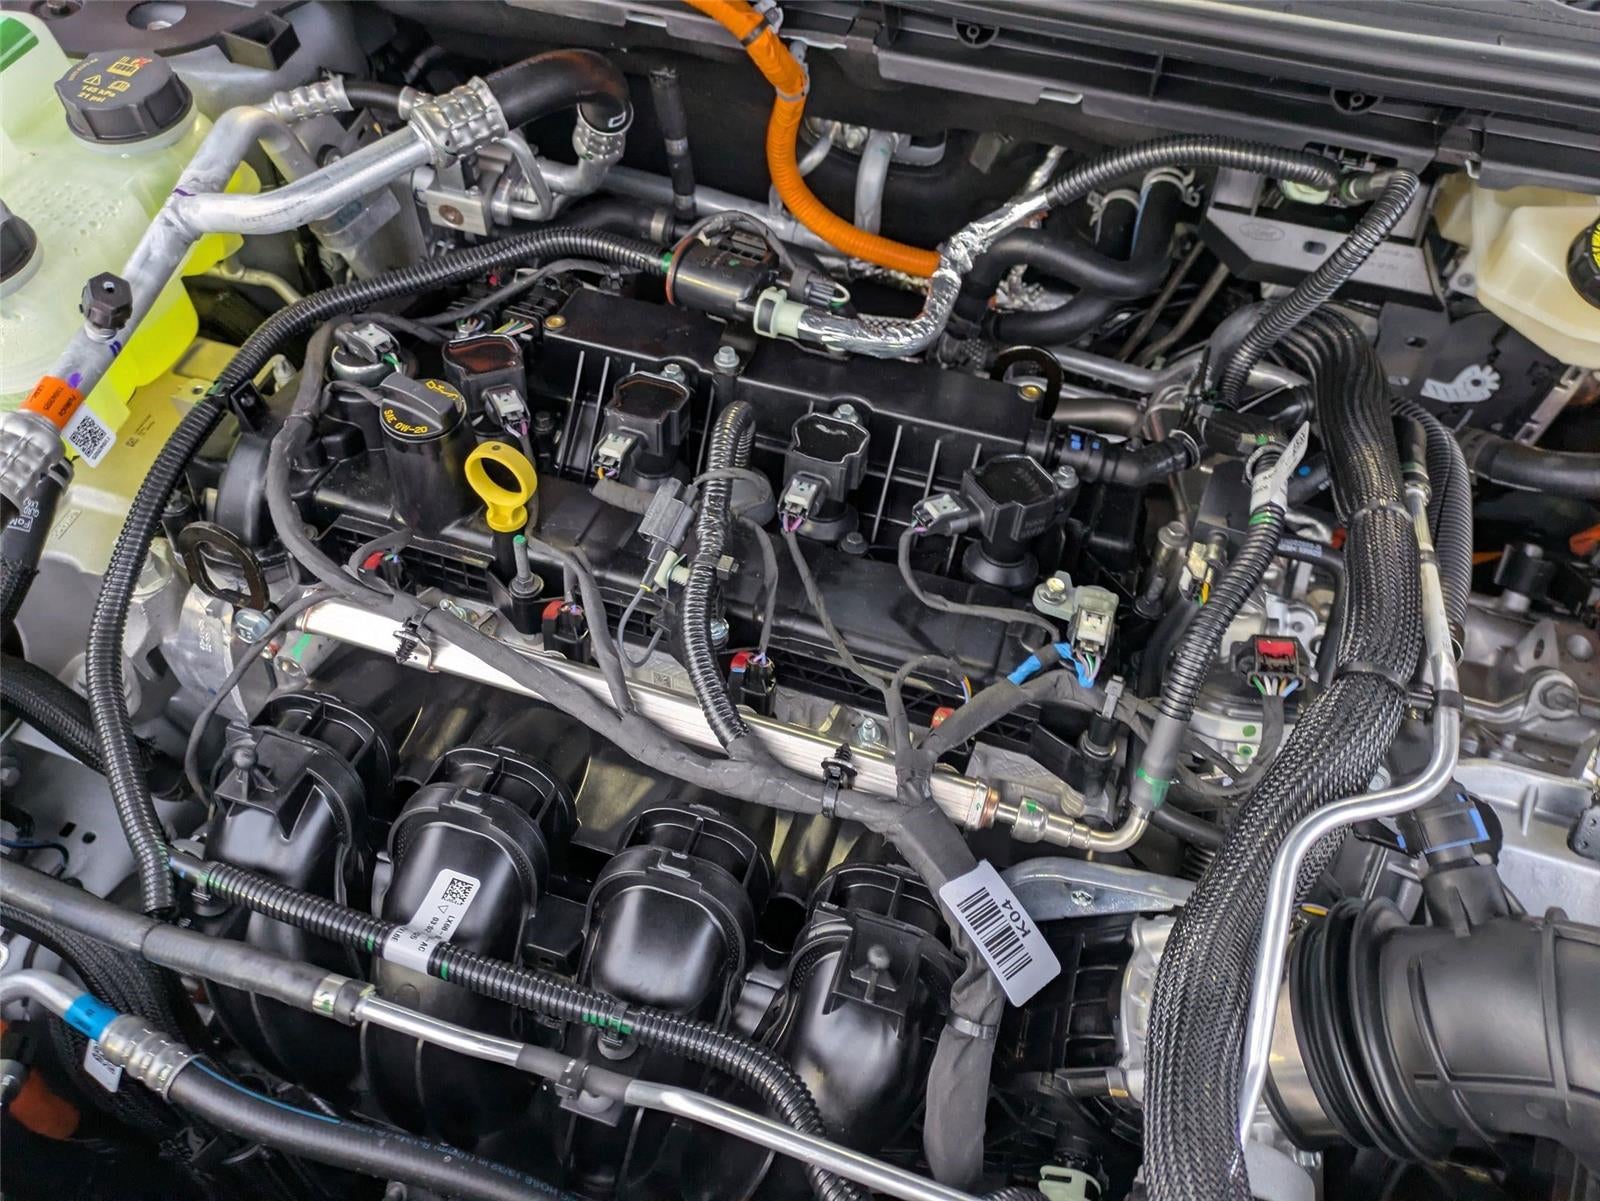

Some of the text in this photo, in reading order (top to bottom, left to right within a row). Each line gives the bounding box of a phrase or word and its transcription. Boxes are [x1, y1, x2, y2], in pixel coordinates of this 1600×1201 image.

[383, 409, 428, 434] SAE 0W-20
[1002, 898, 1031, 938] K04
